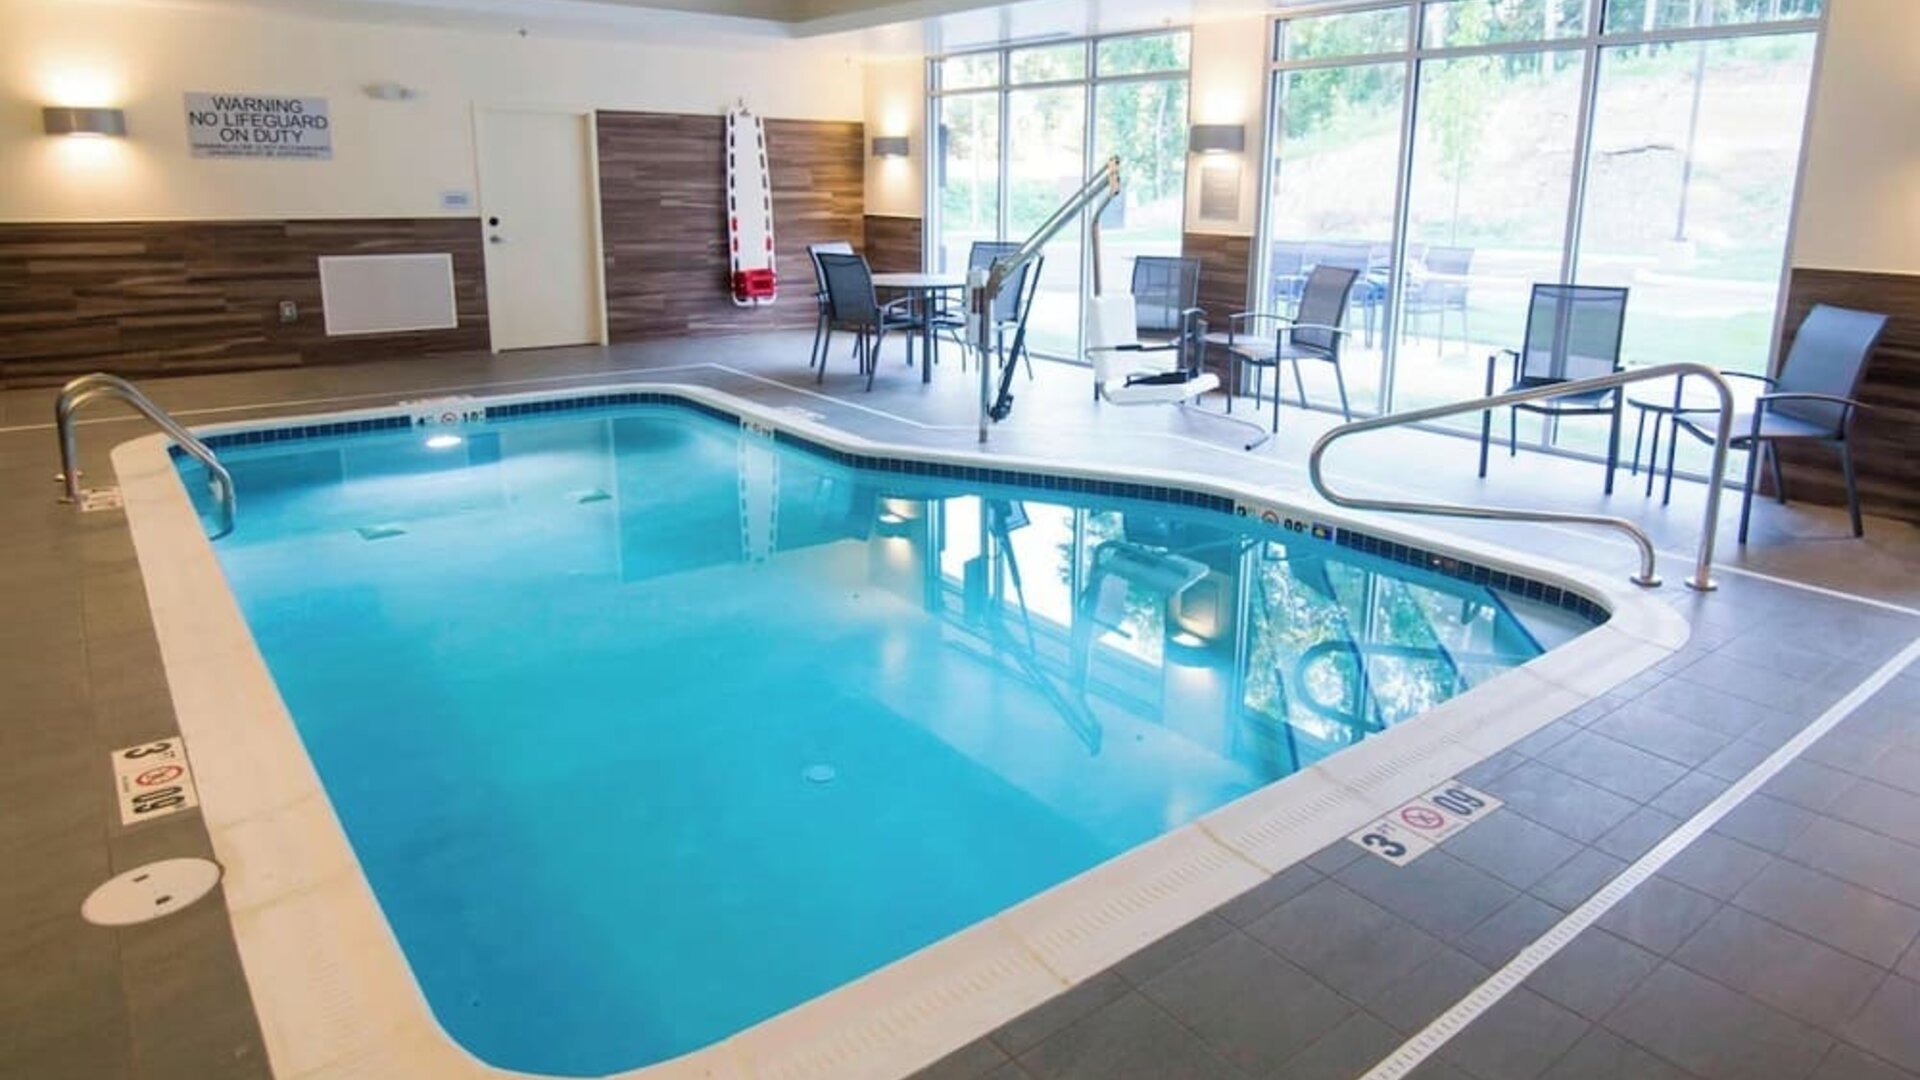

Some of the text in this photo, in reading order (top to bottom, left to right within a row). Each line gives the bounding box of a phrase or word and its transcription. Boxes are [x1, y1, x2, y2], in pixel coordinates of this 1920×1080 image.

[212, 96, 303, 114] WARNING
[189, 111, 328, 130] NO LIFEGUARD
[220, 128, 303, 143] ON DUTY
